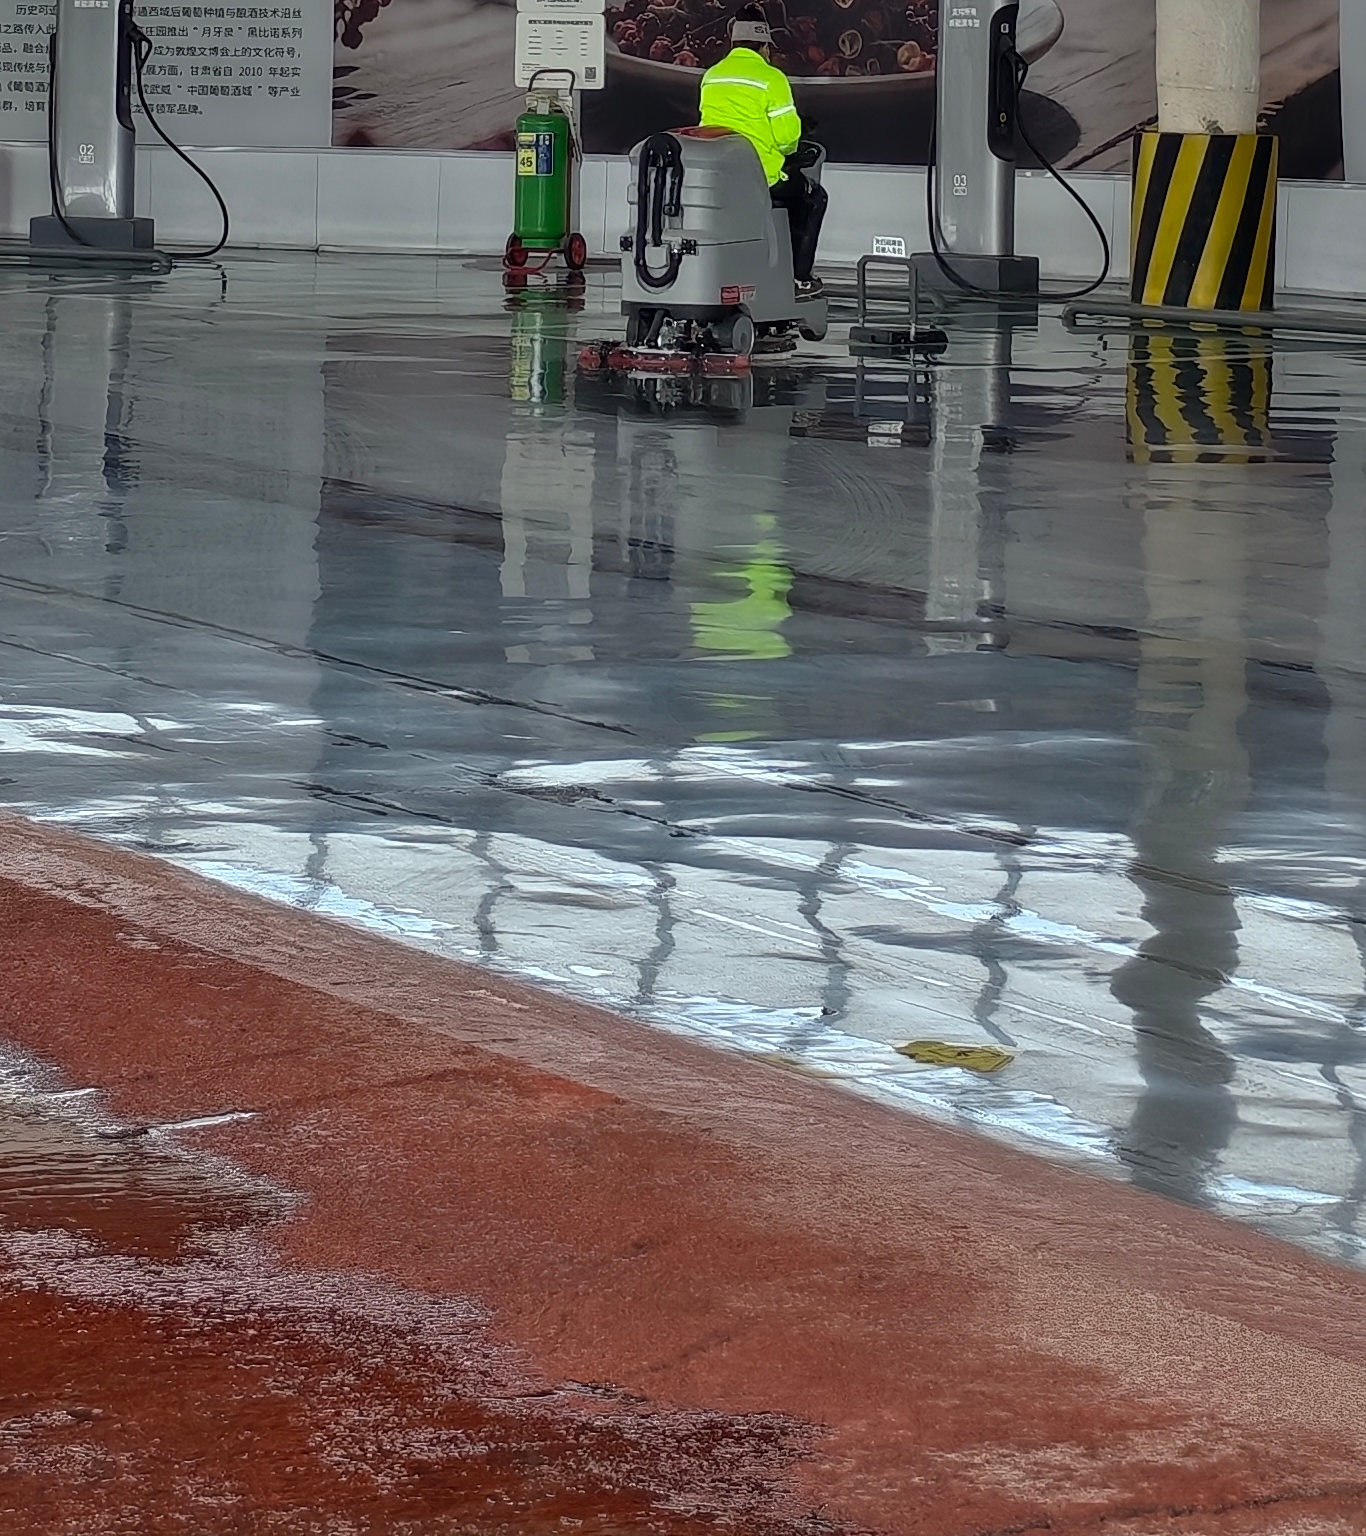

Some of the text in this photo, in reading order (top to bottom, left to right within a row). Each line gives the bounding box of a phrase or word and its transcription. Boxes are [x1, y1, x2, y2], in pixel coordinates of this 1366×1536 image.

[238, 66, 263, 78] 2010
[79, 144, 95, 156] 02
[519, 156, 534, 168] 45
[953, 174, 968, 187] 03
